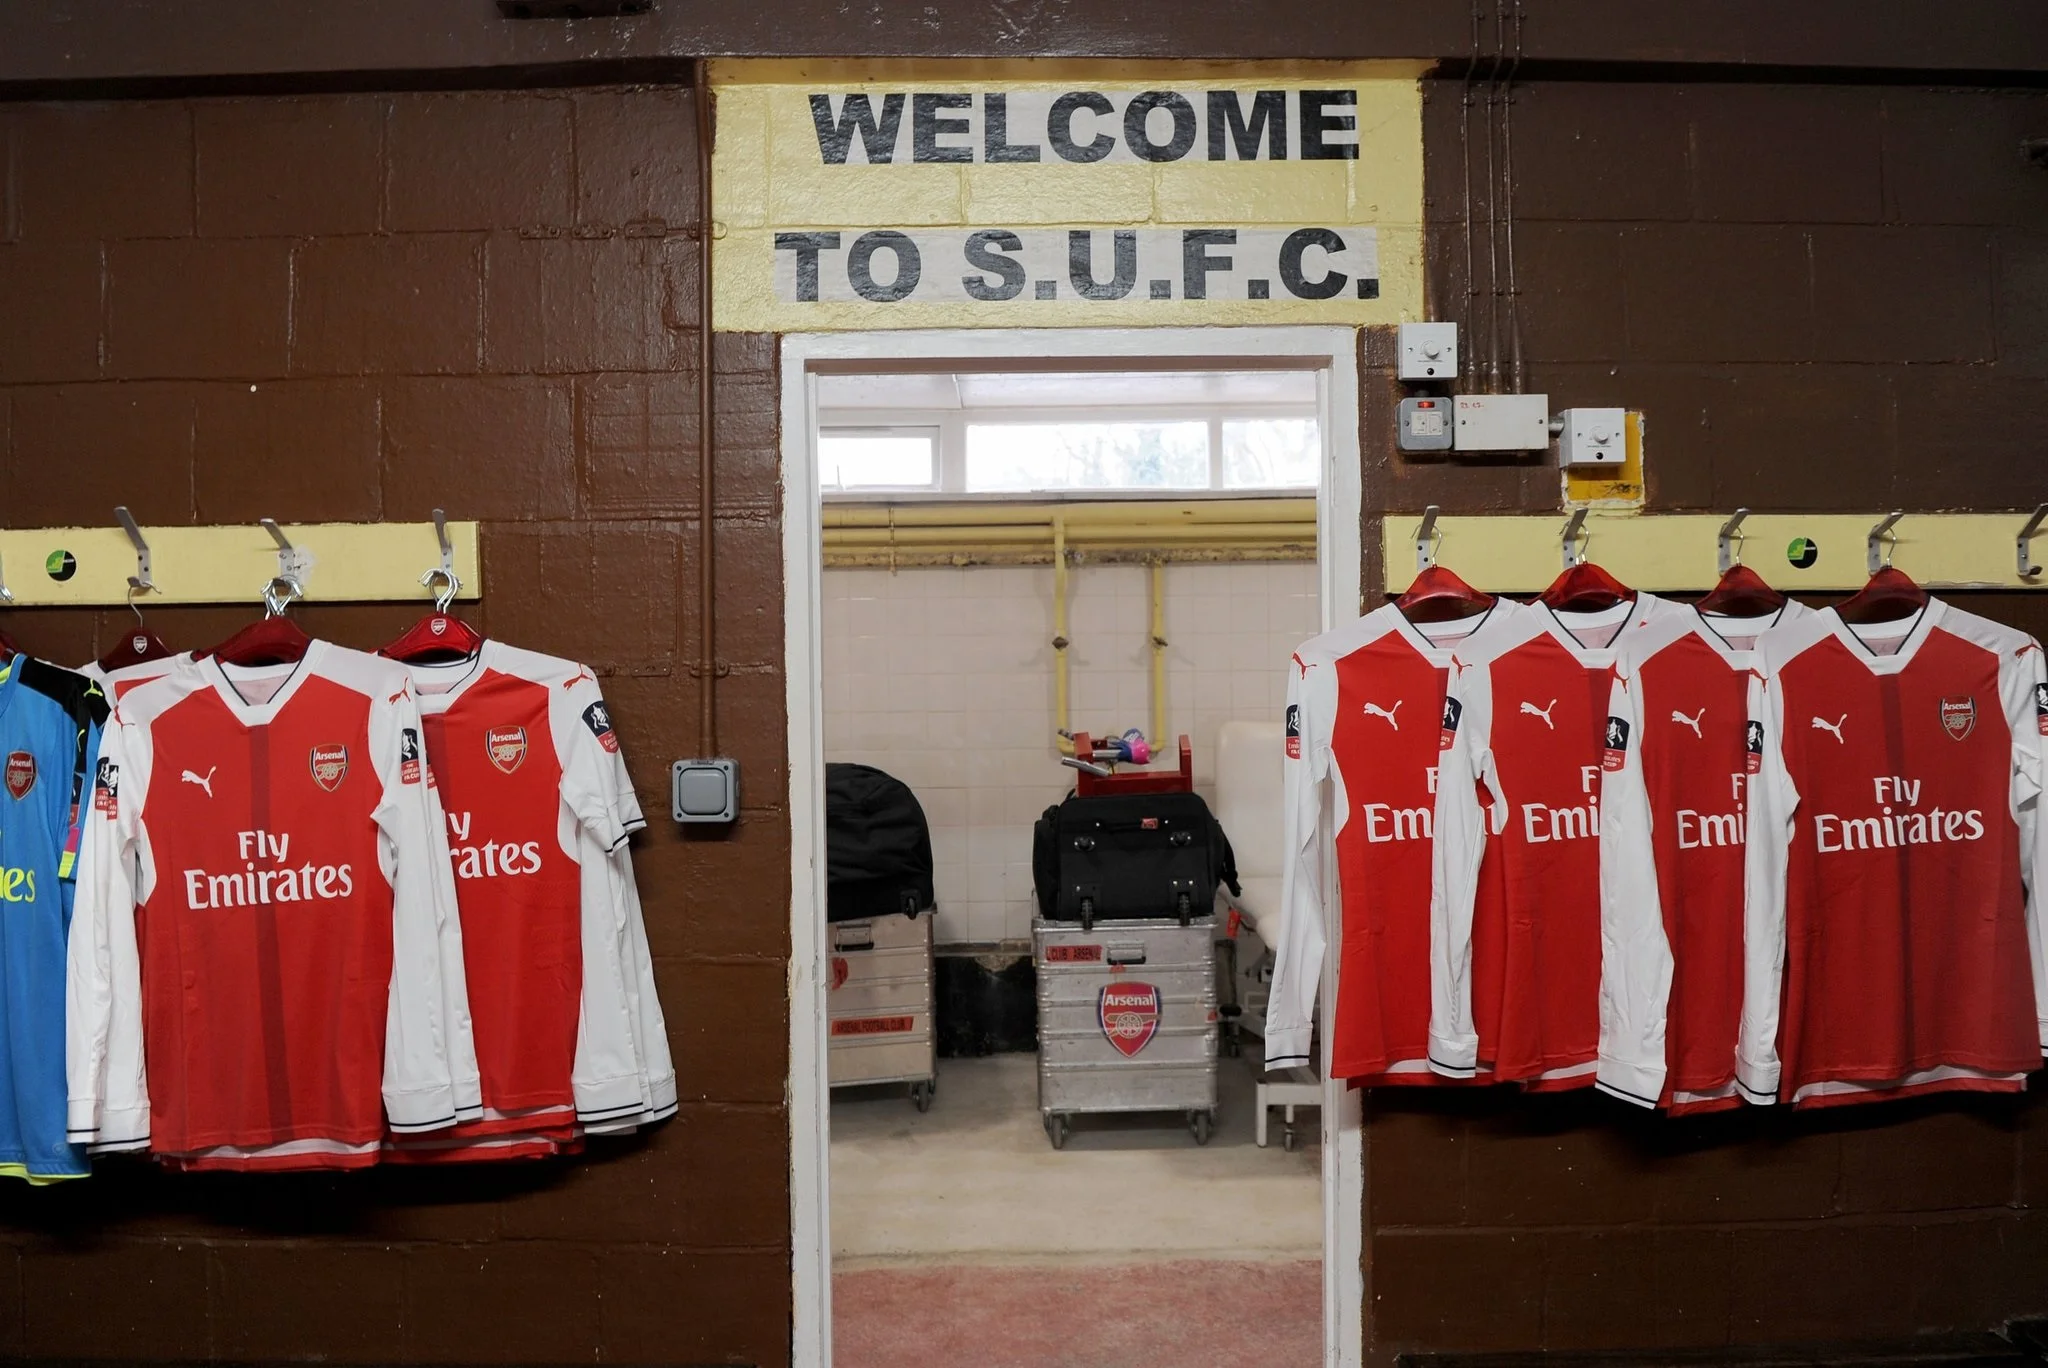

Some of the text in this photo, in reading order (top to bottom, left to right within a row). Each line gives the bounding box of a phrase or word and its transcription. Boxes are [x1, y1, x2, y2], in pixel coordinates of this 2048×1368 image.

[808, 90, 1359, 164] WELCOME
[774, 227, 1380, 303] TO S.U.F.C.
[491, 731, 521, 743] Arsenal
[315, 750, 344, 761] Arsenal
[1579, 765, 1600, 793] F
[1873, 775, 1921, 807] Fly
[237, 829, 290, 863] Fly
[1814, 806, 1985, 853] Emirates
[183, 860, 354, 910] Emirates
[1104, 993, 1154, 1007] Arsenal
